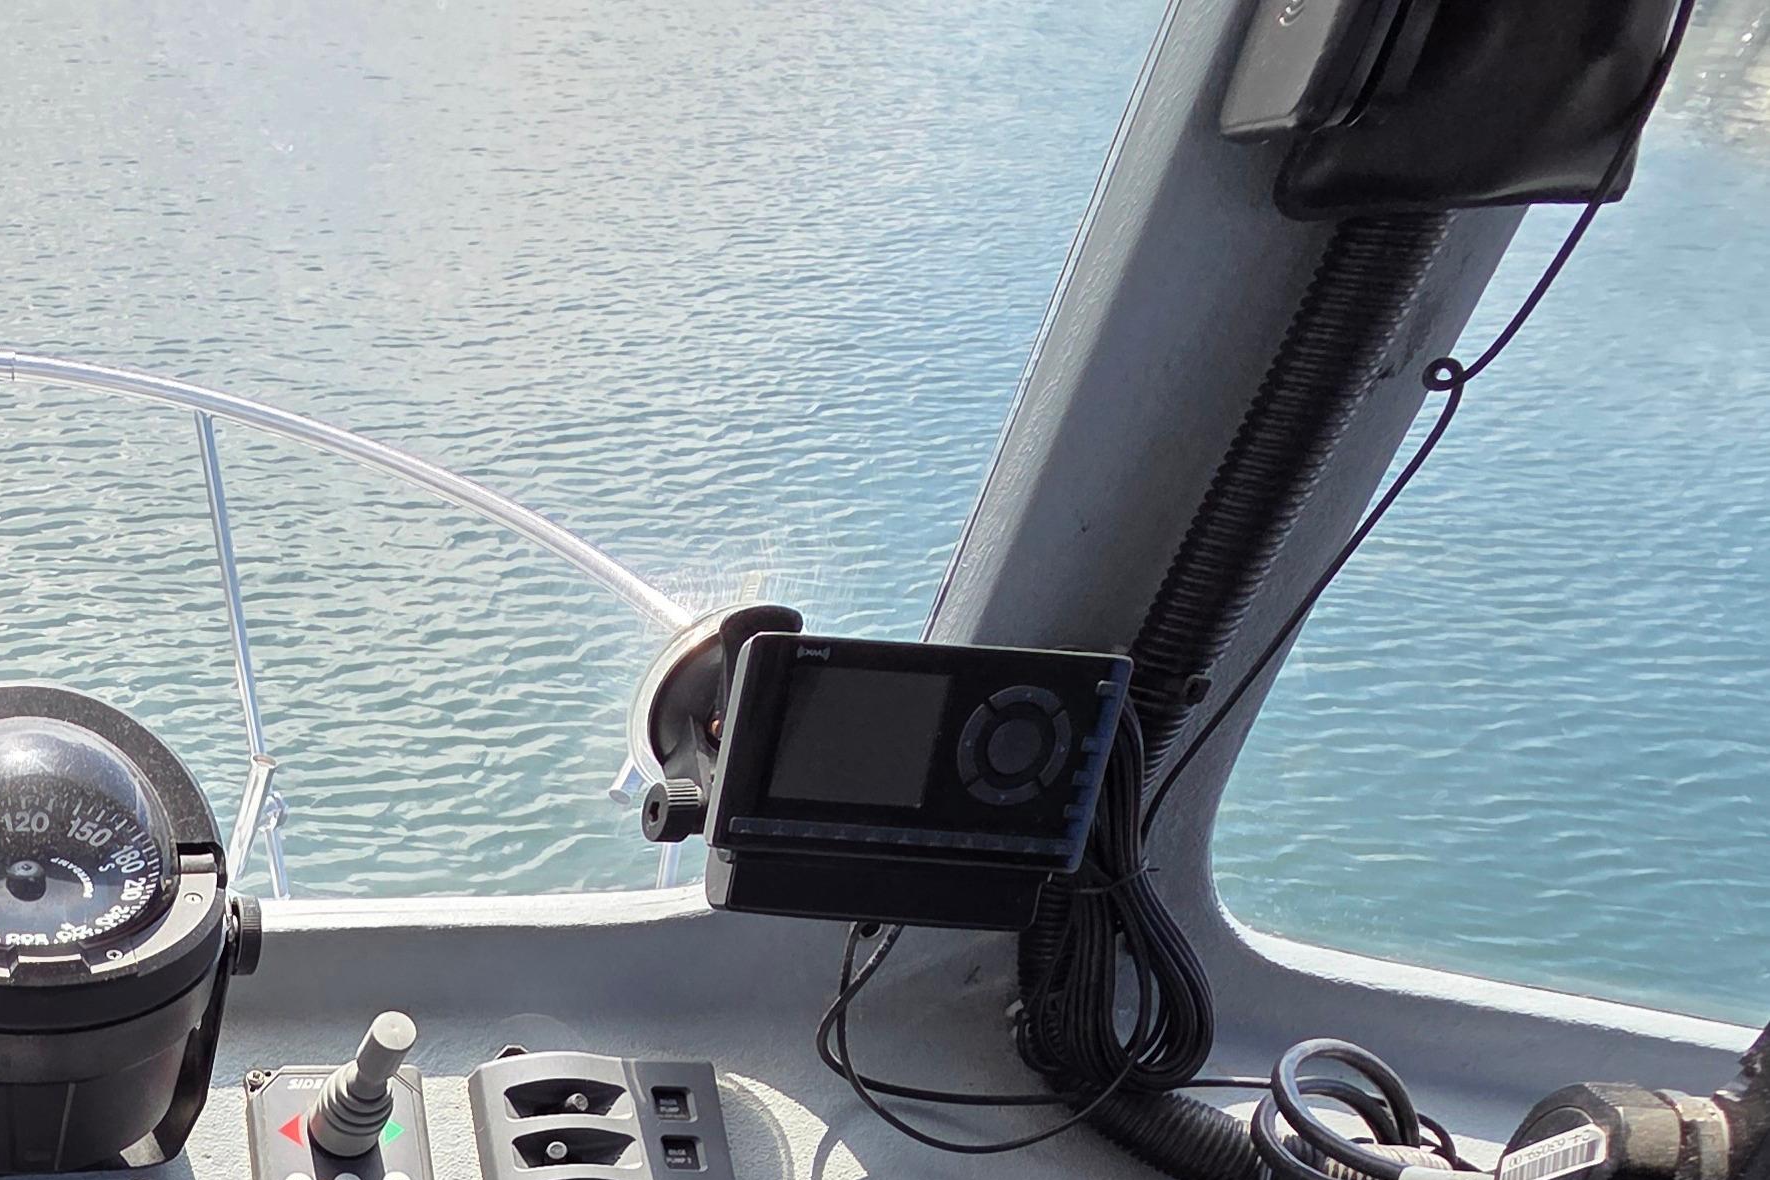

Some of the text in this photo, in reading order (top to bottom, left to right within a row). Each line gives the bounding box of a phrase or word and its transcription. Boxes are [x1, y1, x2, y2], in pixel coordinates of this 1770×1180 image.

[5, 811, 49, 833] 120
[66, 818, 114, 848] 150
[98, 862, 116, 873] S
[111, 845, 147, 874] 180
